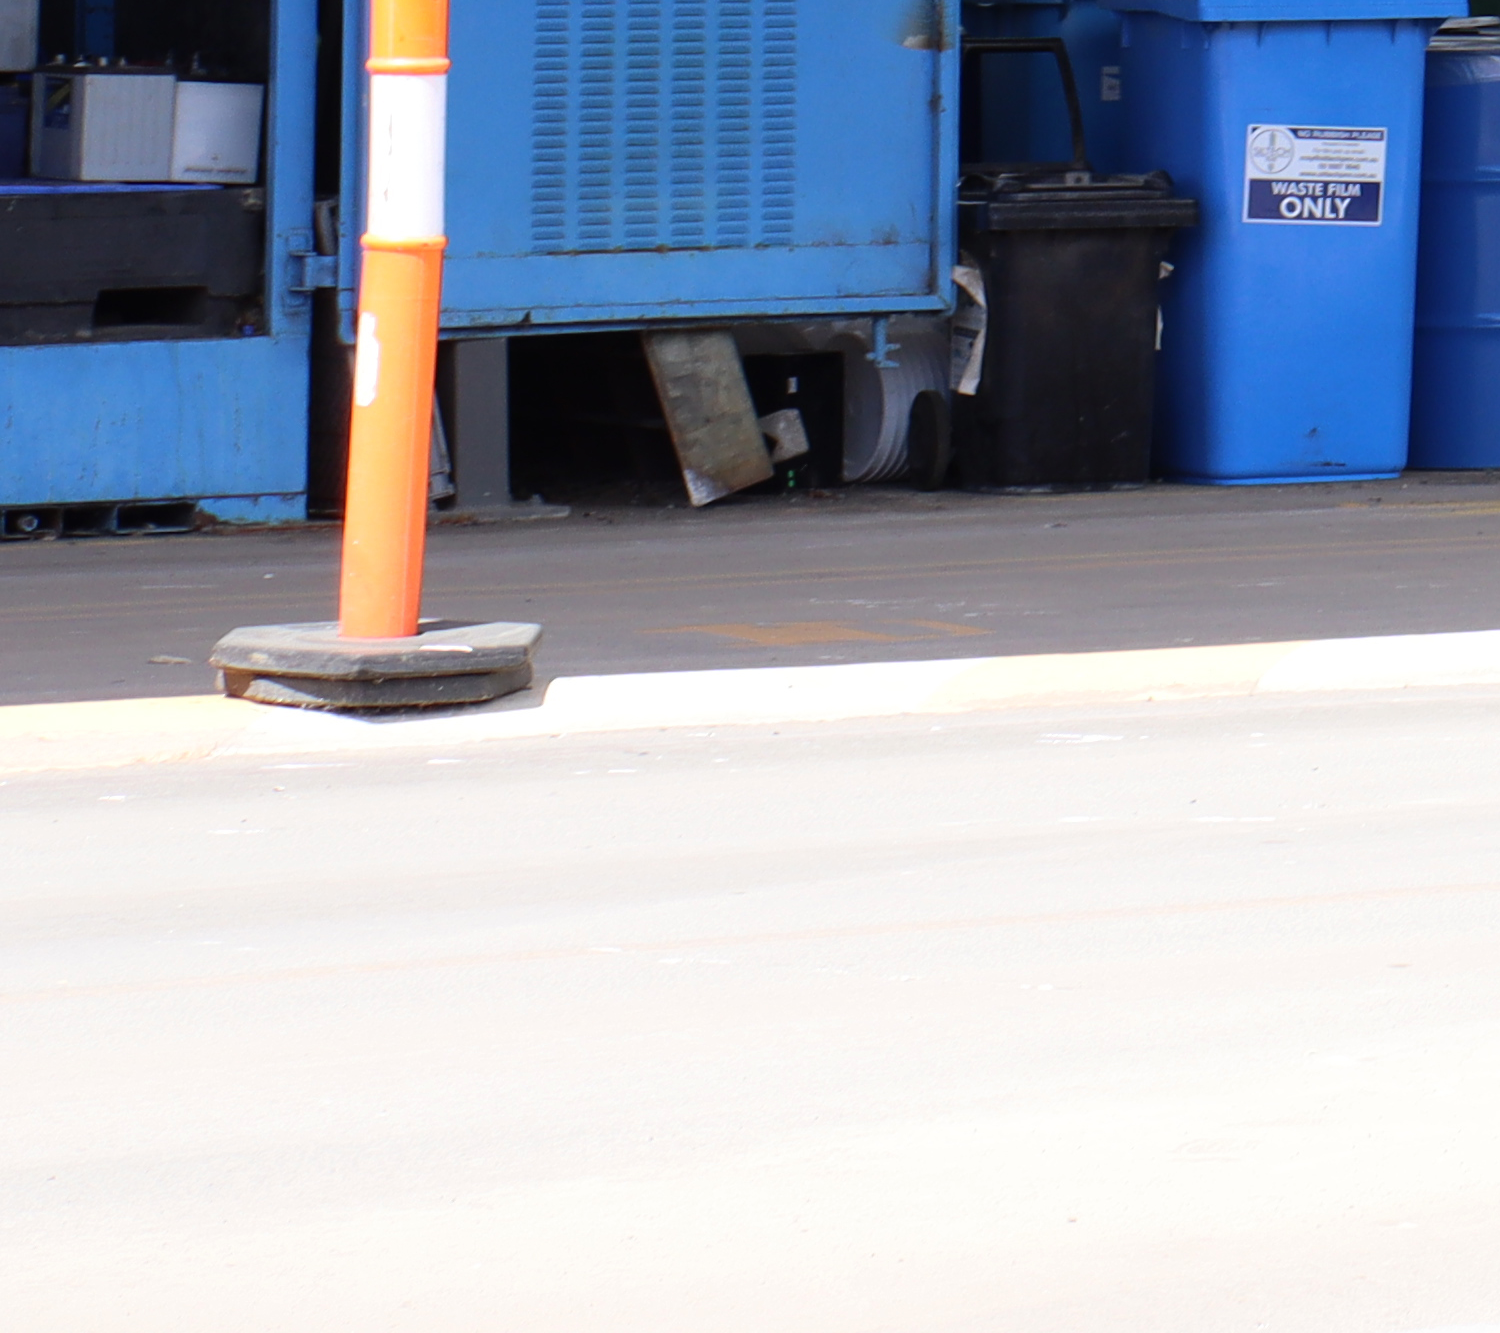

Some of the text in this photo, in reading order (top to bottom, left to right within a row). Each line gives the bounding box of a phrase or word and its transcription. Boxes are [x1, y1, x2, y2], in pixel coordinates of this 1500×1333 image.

[1271, 182, 1361, 197] WASTE FILM
[1279, 196, 1351, 219] ONLY
